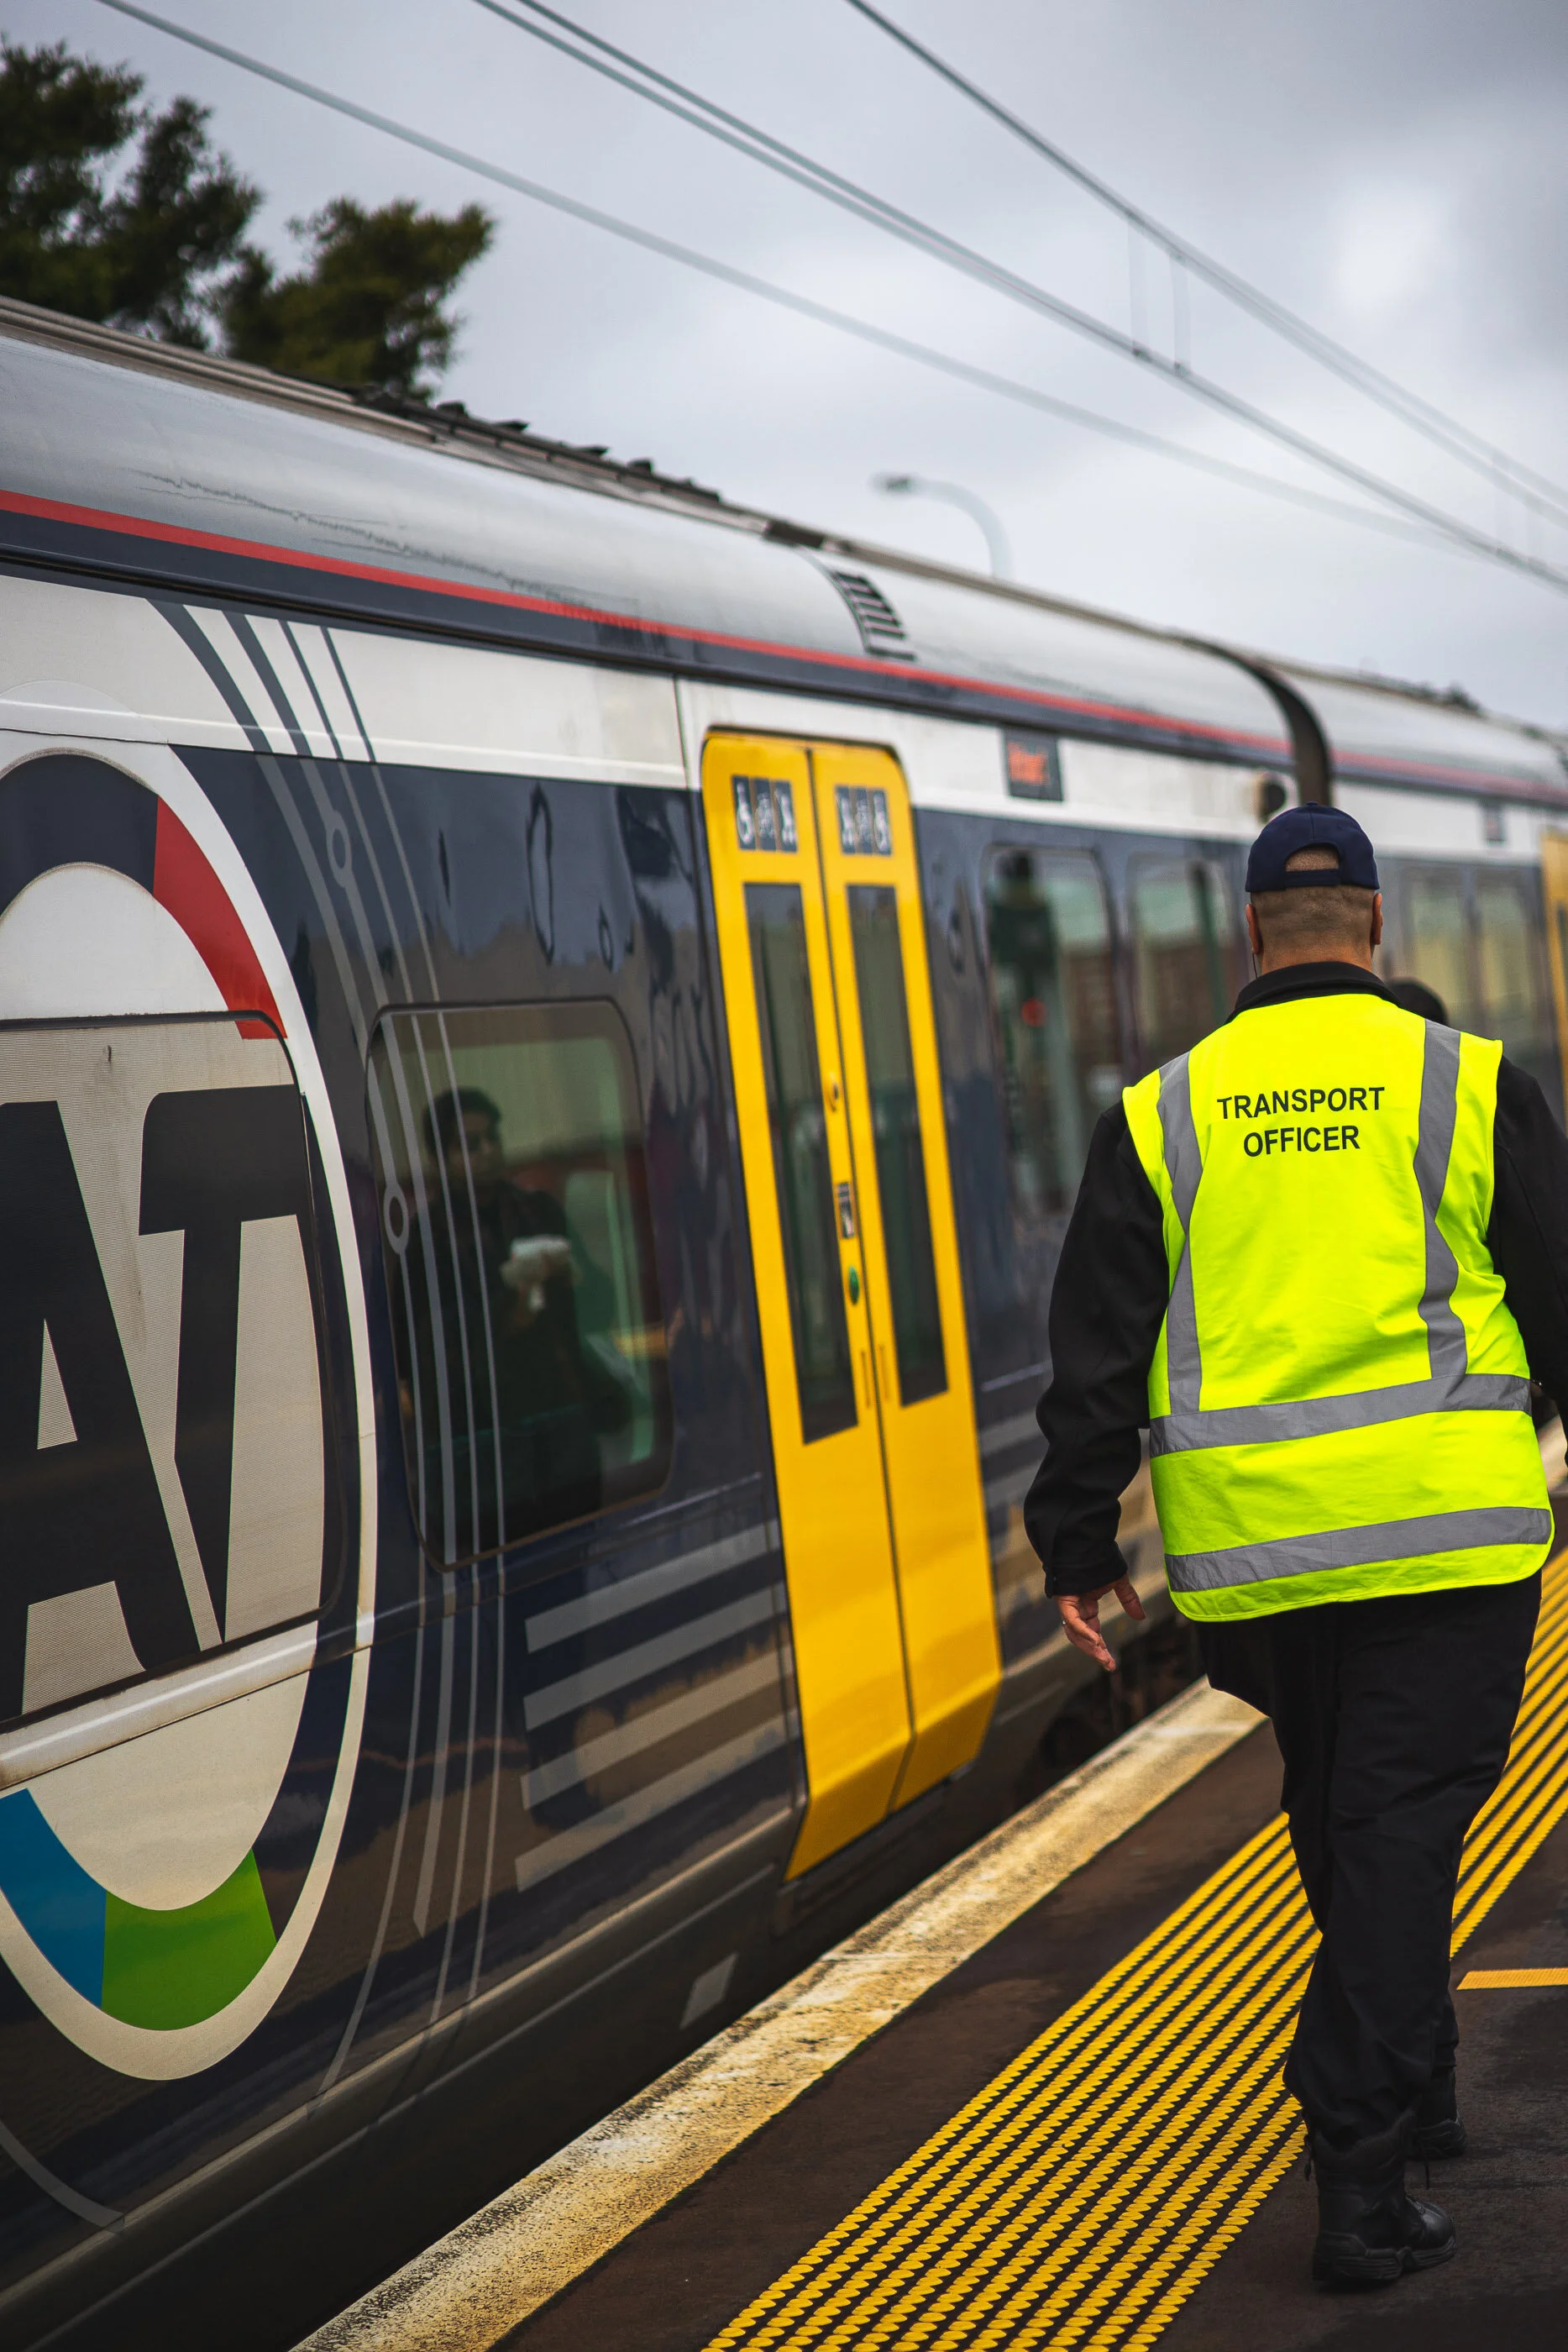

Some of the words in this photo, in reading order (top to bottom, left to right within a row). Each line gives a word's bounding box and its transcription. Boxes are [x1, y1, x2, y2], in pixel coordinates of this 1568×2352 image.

[1216, 1086, 1385, 1120] TRANSPORT
[1243, 1125, 1361, 1158] OFFICER
[0, 1084, 306, 1720] AT
